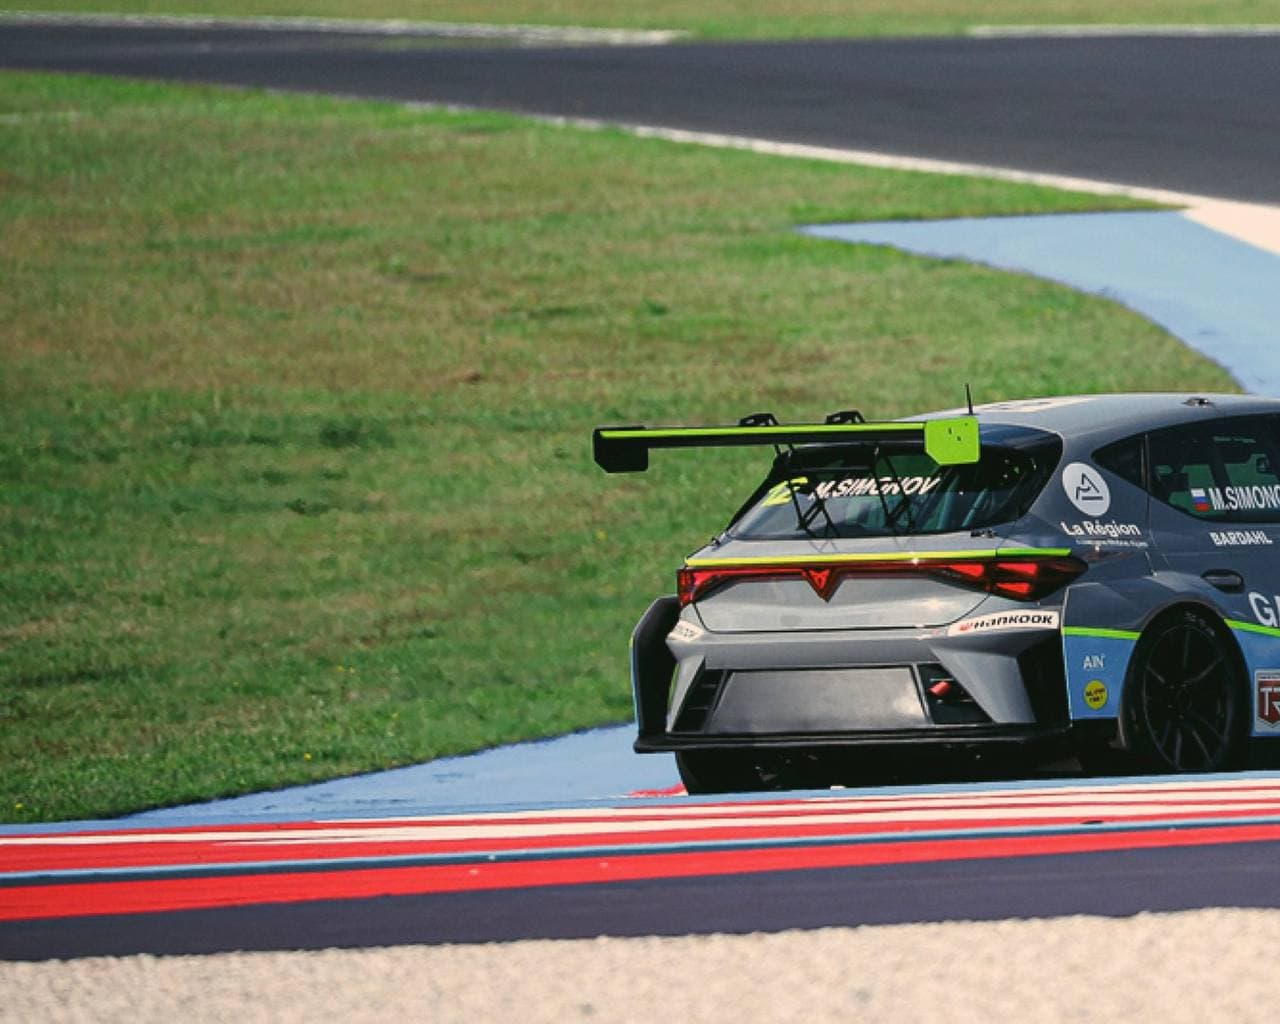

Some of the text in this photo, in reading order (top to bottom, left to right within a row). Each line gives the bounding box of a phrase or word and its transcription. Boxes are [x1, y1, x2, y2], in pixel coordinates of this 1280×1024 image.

[1061, 519, 1141, 537] La Région
[1209, 531, 1273, 545] BARDAHL
